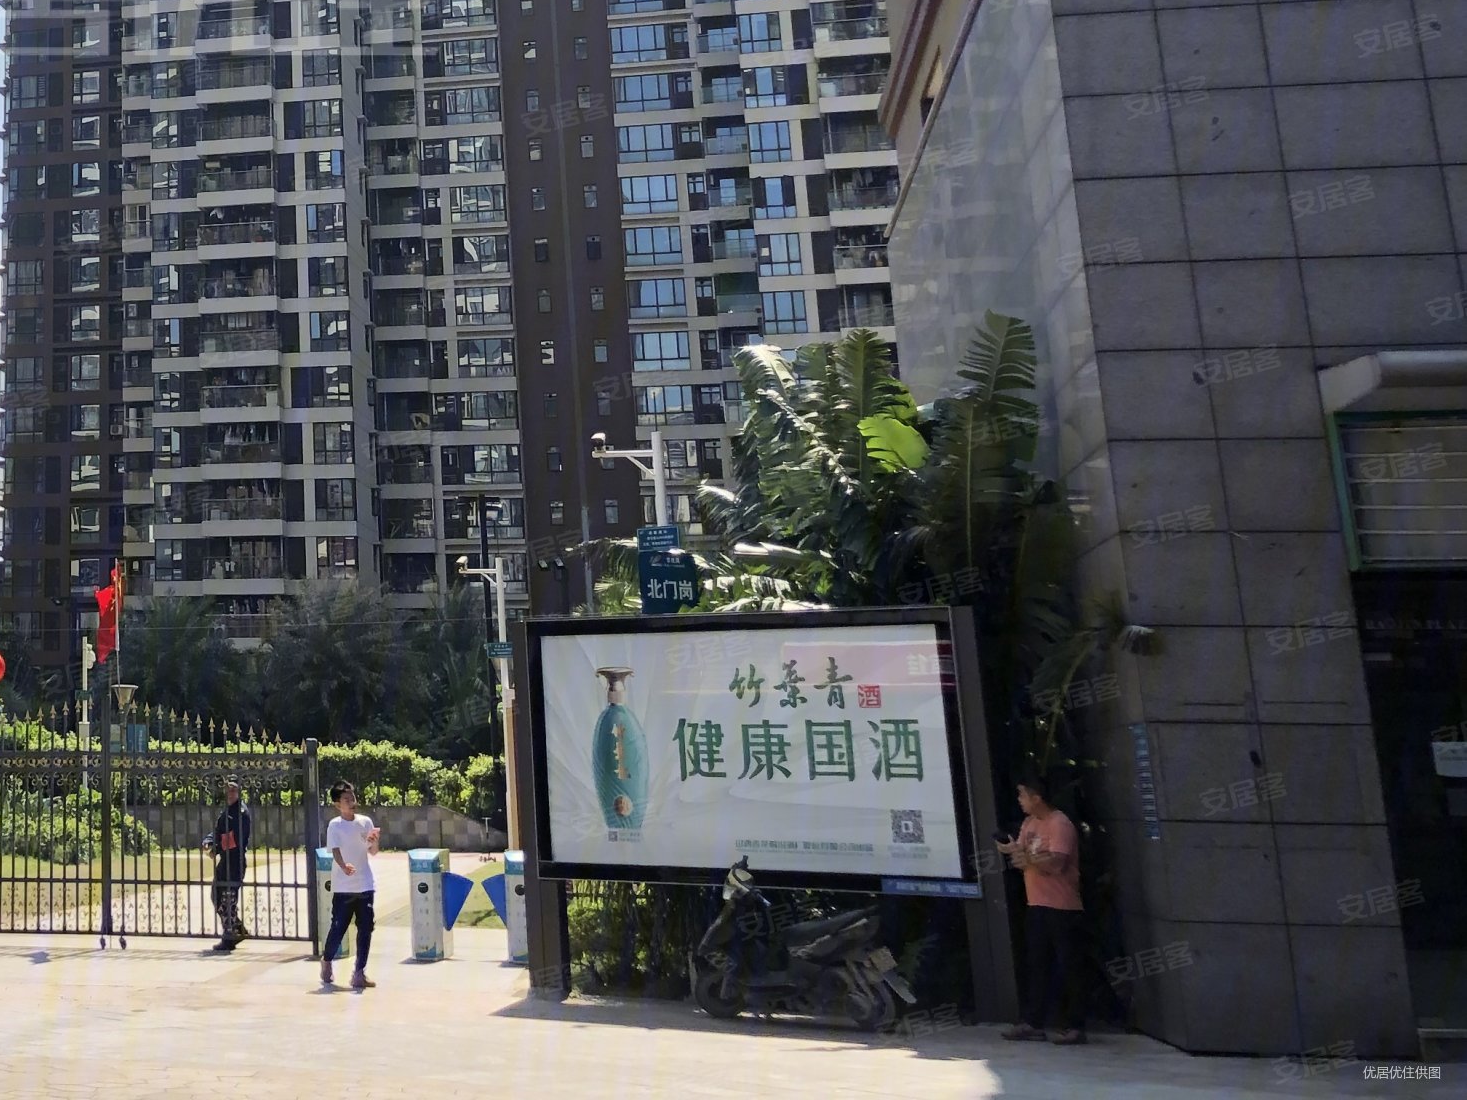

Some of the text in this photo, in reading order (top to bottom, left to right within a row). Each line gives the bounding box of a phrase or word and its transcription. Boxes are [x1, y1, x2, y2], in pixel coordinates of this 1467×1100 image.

[647, 578, 694, 601] 北门岗
[857, 683, 882, 709] 酒
[672, 717, 924, 782] 健康国酒
